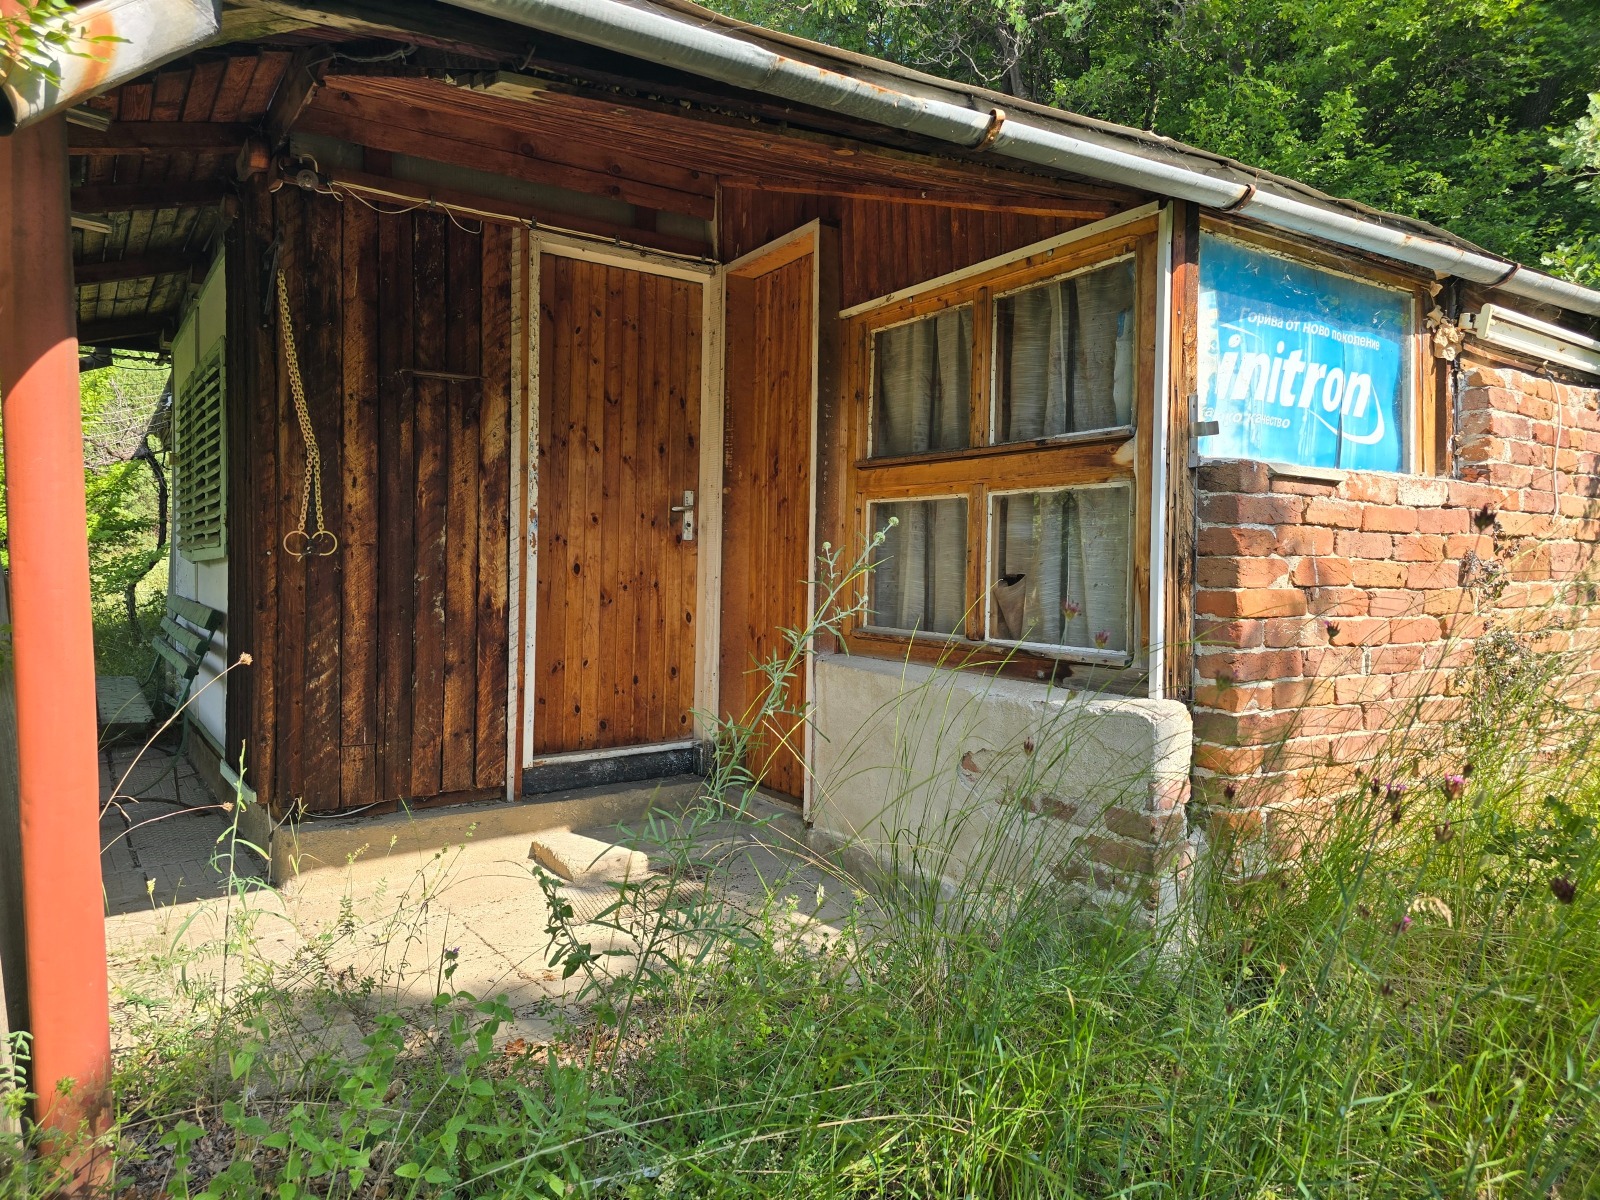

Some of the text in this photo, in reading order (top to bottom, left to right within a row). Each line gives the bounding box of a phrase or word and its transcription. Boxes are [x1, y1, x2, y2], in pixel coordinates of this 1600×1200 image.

[1239, 307, 1284, 329] Горива
[1302, 321, 1330, 337] ново
[1331, 329, 1380, 351] поколение
[1203, 334, 1372, 418] initron
[1246, 412, 1291, 429] качество
